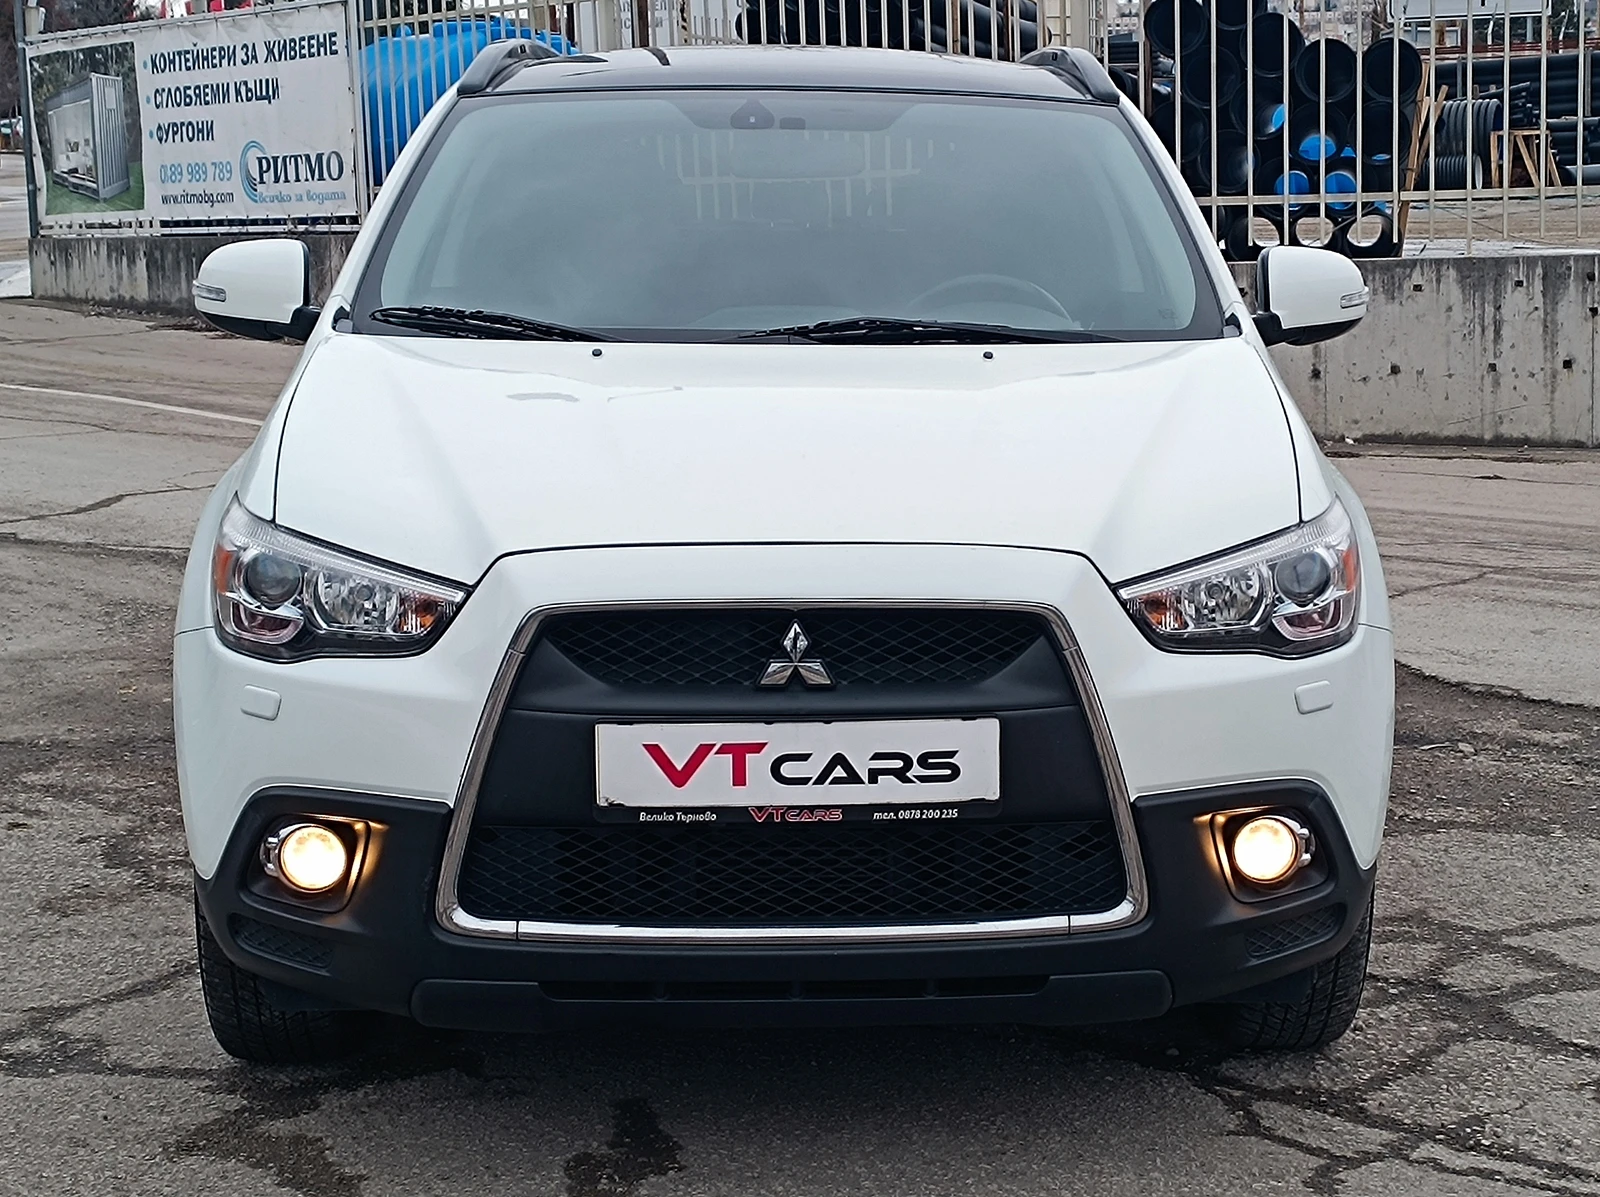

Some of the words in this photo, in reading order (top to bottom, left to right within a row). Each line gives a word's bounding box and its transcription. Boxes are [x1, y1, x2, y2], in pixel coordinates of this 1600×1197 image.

[150, 42, 236, 74] КОНТЕЙНЕРИ
[240, 42, 259, 66] ЗА
[263, 31, 339, 64] ЖИВЕЕНЕ
[154, 81, 231, 109] СГЛОБЯЕМИ
[234, 77, 280, 105] КЪЩИ
[156, 120, 214, 144] ФУРГОНИ
[186, 162, 208, 183] 989
[211, 160, 233, 182] 789
[256, 150, 345, 185] РИТМО
[639, 811, 674, 822] Велико
[676, 811, 717, 823] Търново
[873, 812, 897, 820] тел.
[898, 809, 921, 820] 0878
[922, 809, 940, 819] 200
[941, 808, 958, 819] 235
